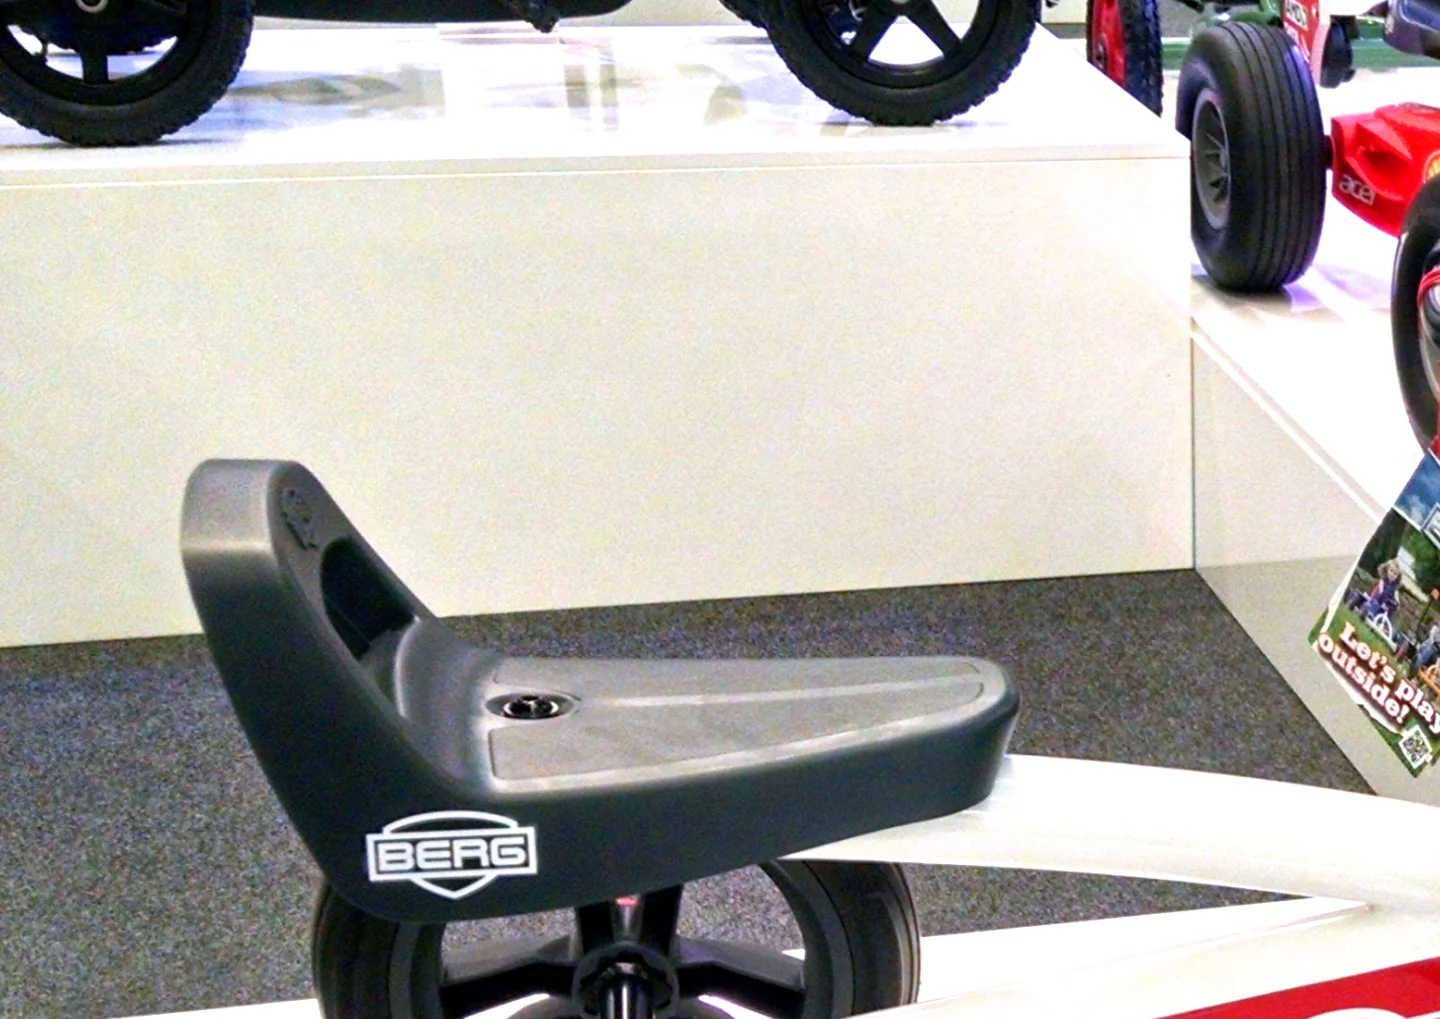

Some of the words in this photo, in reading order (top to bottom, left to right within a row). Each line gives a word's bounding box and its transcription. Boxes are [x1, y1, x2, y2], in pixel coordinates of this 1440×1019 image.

[1318, 632, 1411, 724] outside!
[1339, 621, 1397, 684] Let's
[376, 836, 528, 872] BERG
